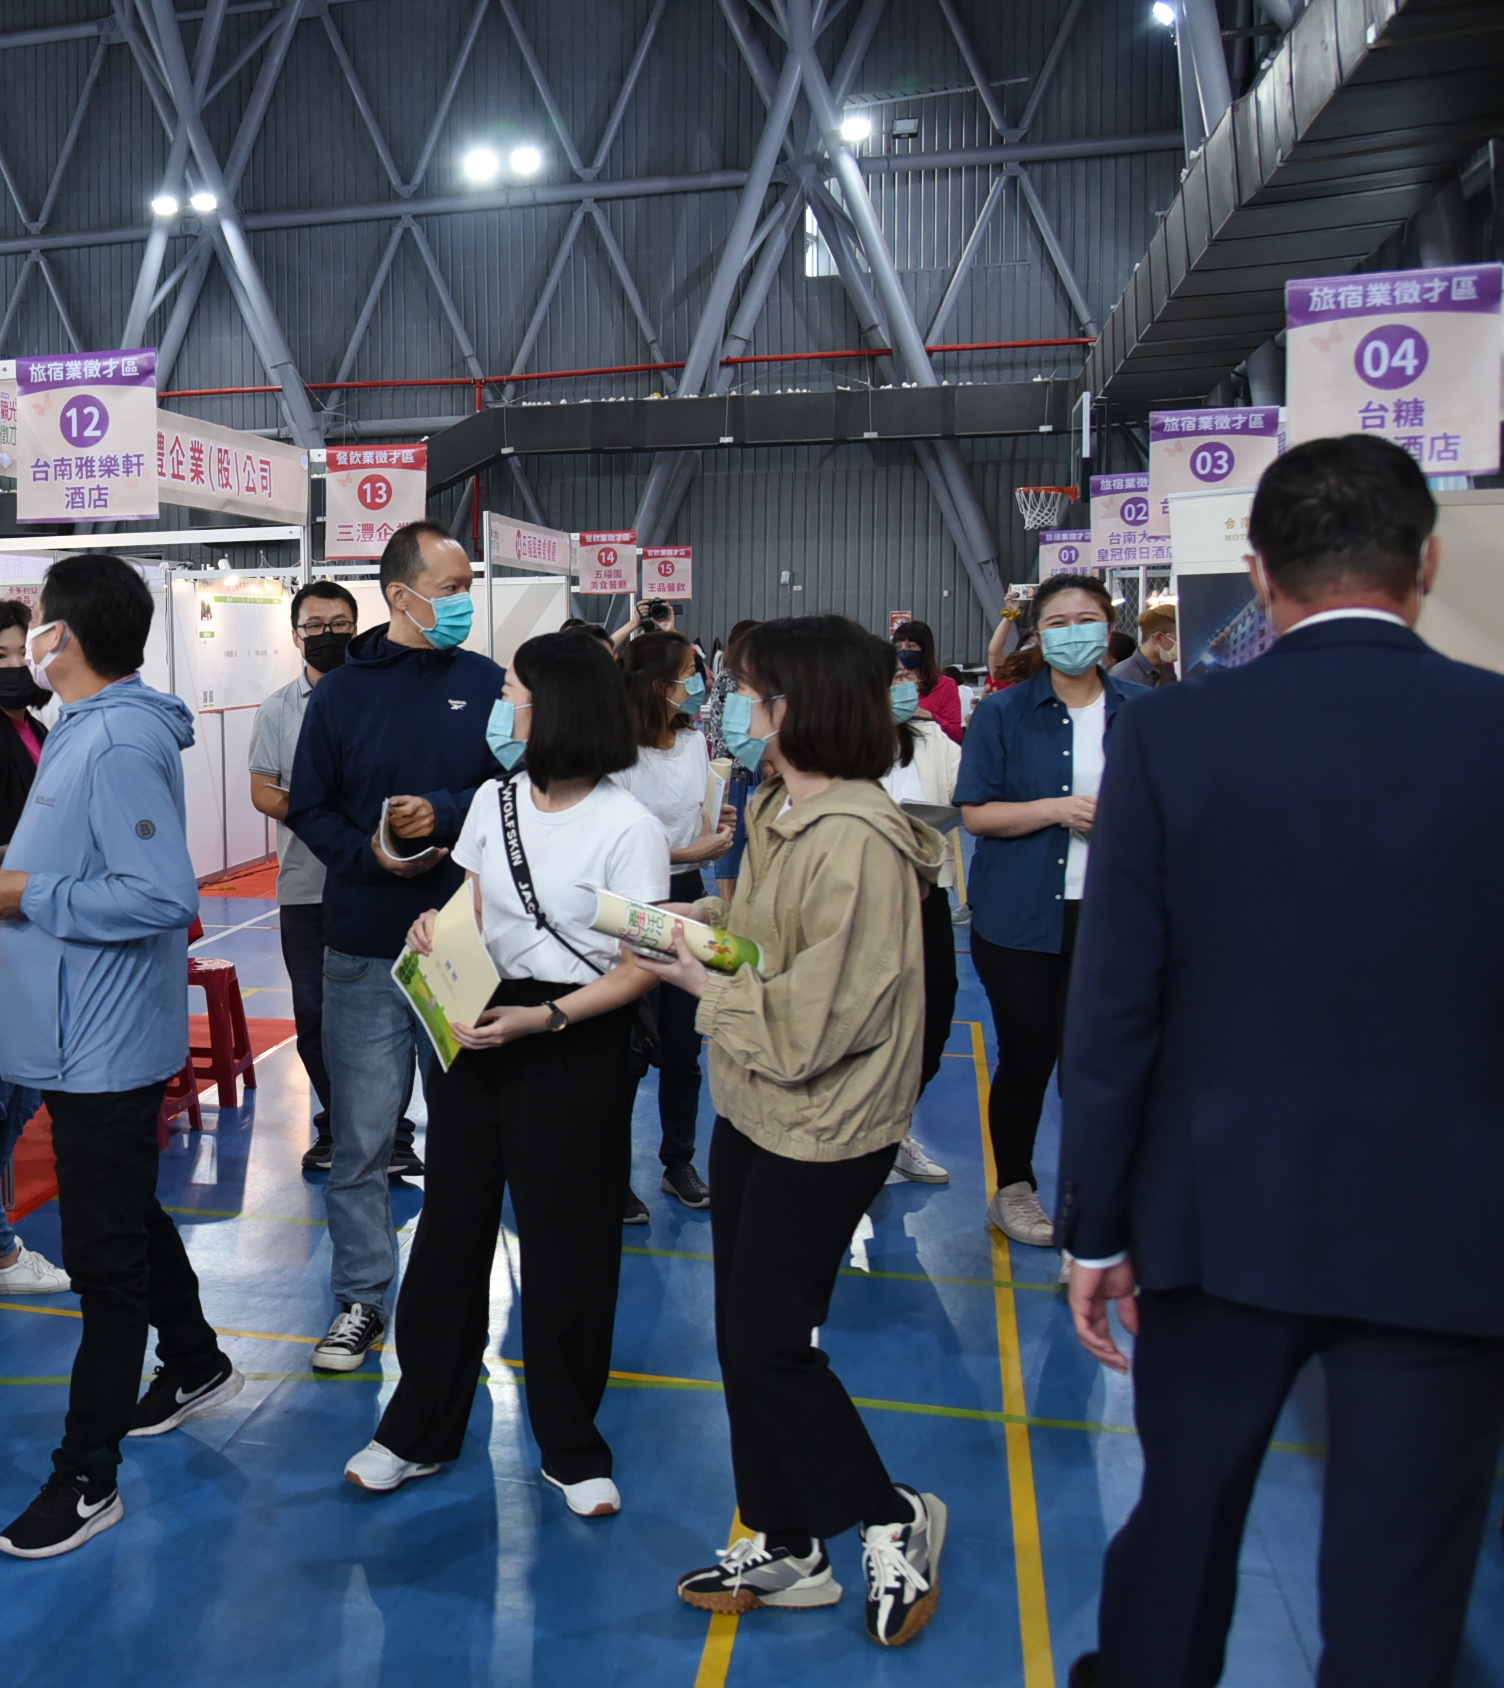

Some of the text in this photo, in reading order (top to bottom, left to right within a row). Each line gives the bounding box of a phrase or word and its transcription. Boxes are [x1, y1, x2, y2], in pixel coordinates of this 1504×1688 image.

[1309, 276, 1479, 312] 旅宿業徵才區
[29, 357, 140, 384] 旅宿業徵才區
[1362, 338, 1419, 379] 04
[65, 406, 101, 438] 12
[1163, 414, 1266, 432] 旅宿業徵才區
[1358, 398, 1425, 430] 台糖
[30, 453, 145, 482] 台南雅樂軒
[336, 450, 415, 465] 餐飲業徵才區
[1195, 451, 1229, 475] 03
[64, 484, 109, 510] 酒店
[363, 482, 387, 503] 13
[1124, 503, 1148, 521] 02
[600, 551, 614, 563] 14
[1060, 550, 1076, 561] 01
[659, 563, 673, 574] 15
[501, 785, 524, 867] WOLFSKIN
